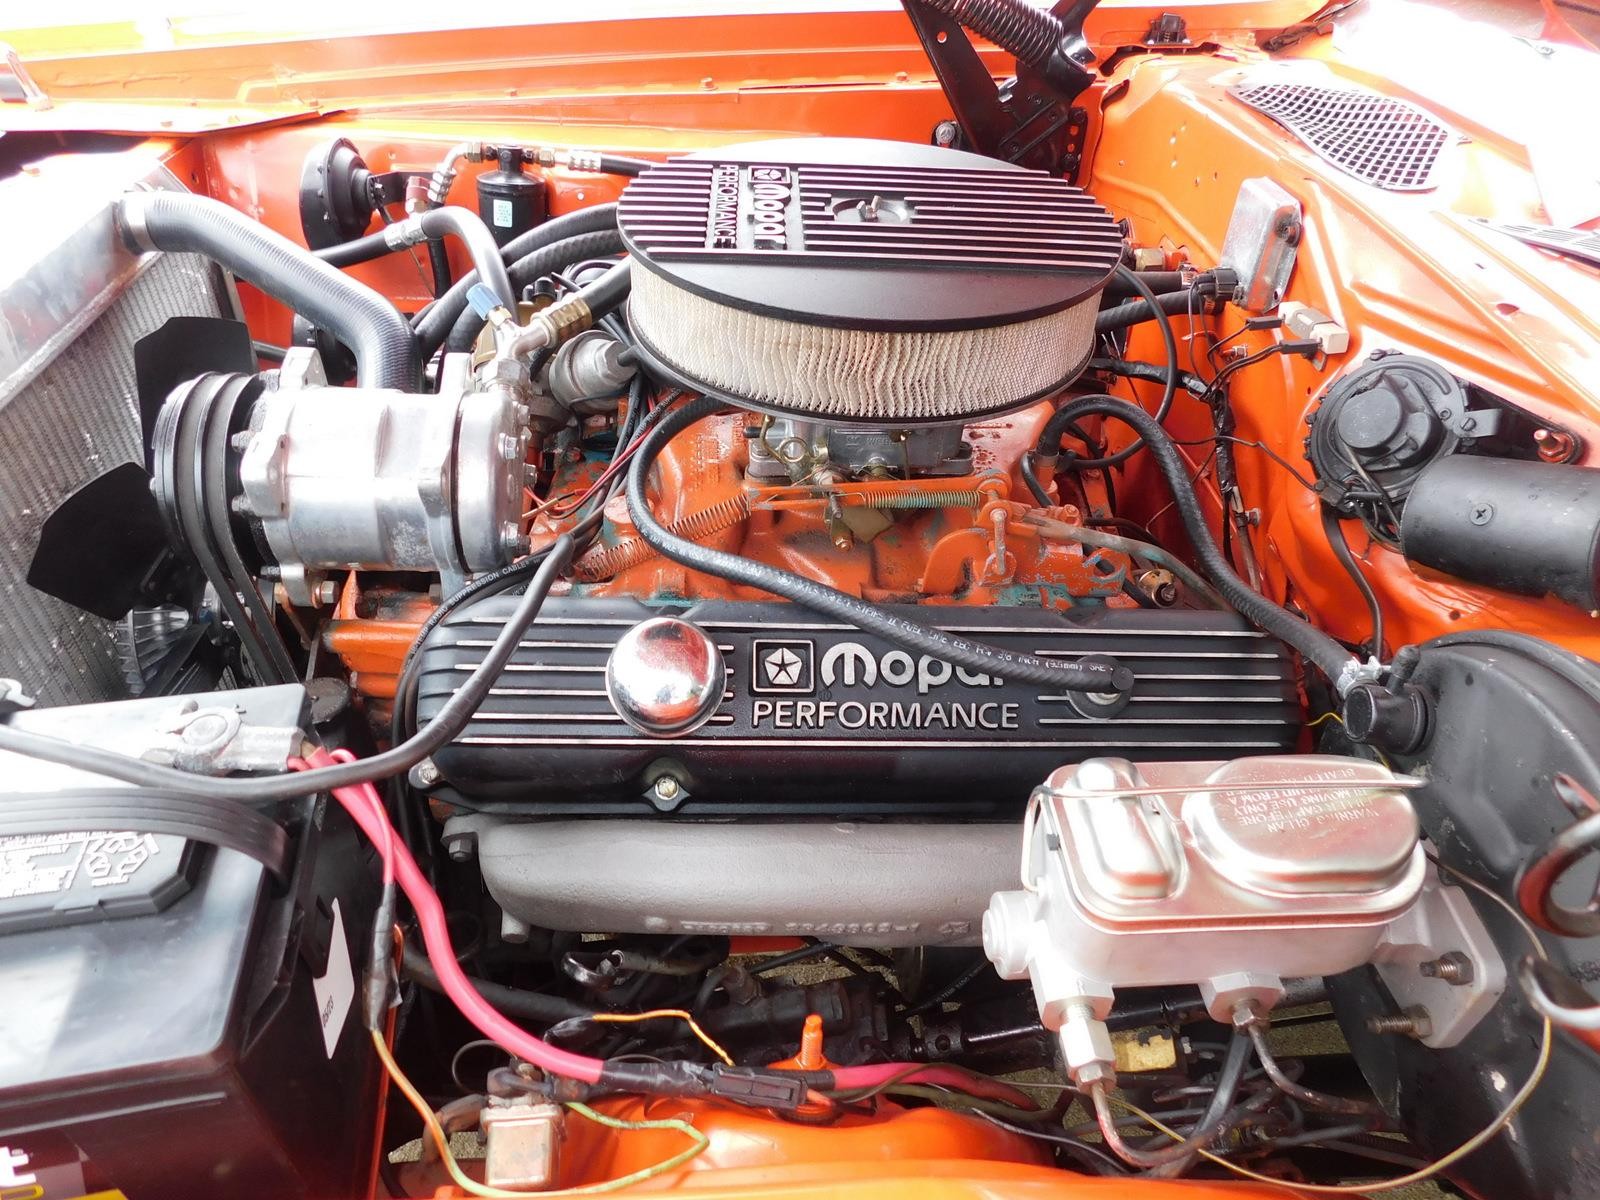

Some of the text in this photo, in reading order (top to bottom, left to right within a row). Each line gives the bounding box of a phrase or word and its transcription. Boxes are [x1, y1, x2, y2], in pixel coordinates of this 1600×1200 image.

[713, 164, 739, 249] PERFORMANCE
[750, 183, 791, 245] Mopar
[429, 606, 448, 627] RADIO
[449, 572, 500, 606] SUPPRESSION
[502, 560, 527, 576] CABLE
[900, 620, 922, 635] FUEL
[820, 642, 1005, 694] Mop
[752, 701, 1020, 729] PERFORMANCE
[1240, 789, 1280, 802] FROM
[1271, 798, 1299, 811] USE
[1232, 802, 1268, 817] ONLY
[1297, 804, 1323, 818] CAP
[1315, 808, 1380, 826] WARNING
